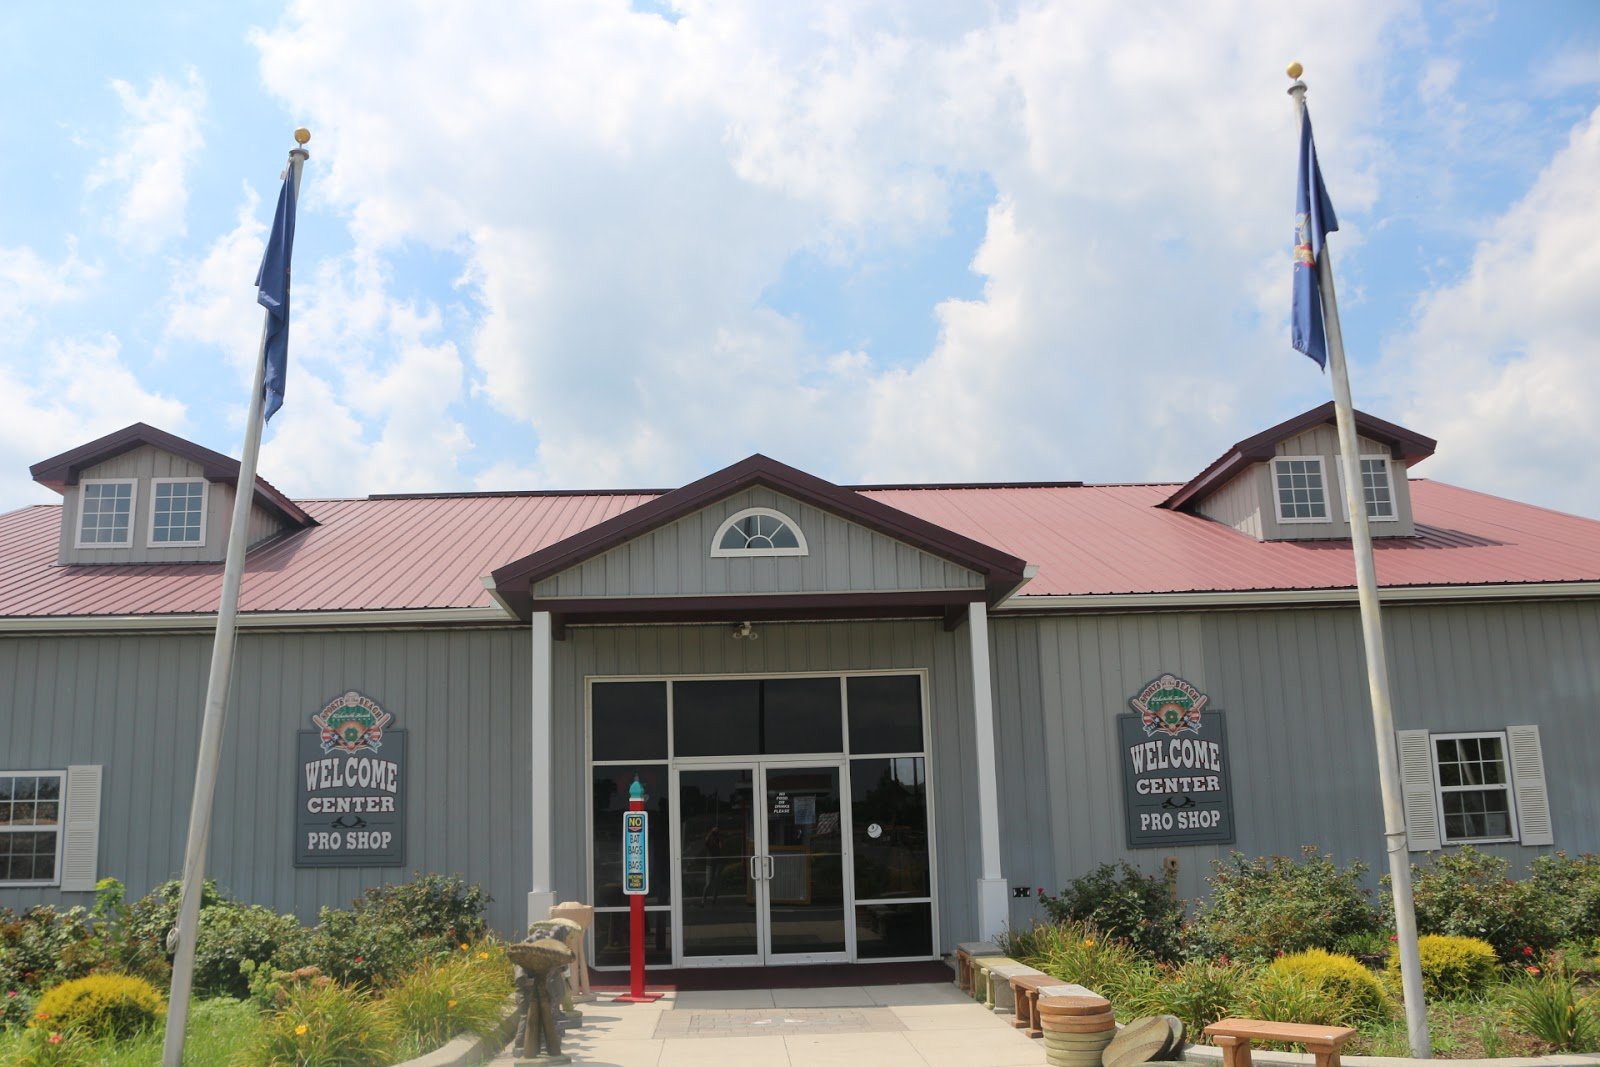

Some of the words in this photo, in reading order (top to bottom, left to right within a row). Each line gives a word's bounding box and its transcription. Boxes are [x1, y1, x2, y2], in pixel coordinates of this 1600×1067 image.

[1140, 682, 1161, 703] SPORTS
[1175, 681, 1199, 699] BEACH
[360, 697, 383, 718] BEACH
[1130, 738, 1221, 775] WELCOME
[305, 757, 398, 793] WELCOME
[1136, 776, 1220, 794] CENTER
[307, 796, 395, 813] CENTER
[629, 818, 642, 827] NO
[1140, 812, 1174, 831] PRO
[1177, 810, 1221, 830] SHOP
[307, 832, 342, 850] PRO
[346, 831, 392, 849] SHOP
[630, 834, 640, 844] BAT
[628, 846, 643, 855] BAGS
[628, 861, 643, 870] BAGS
